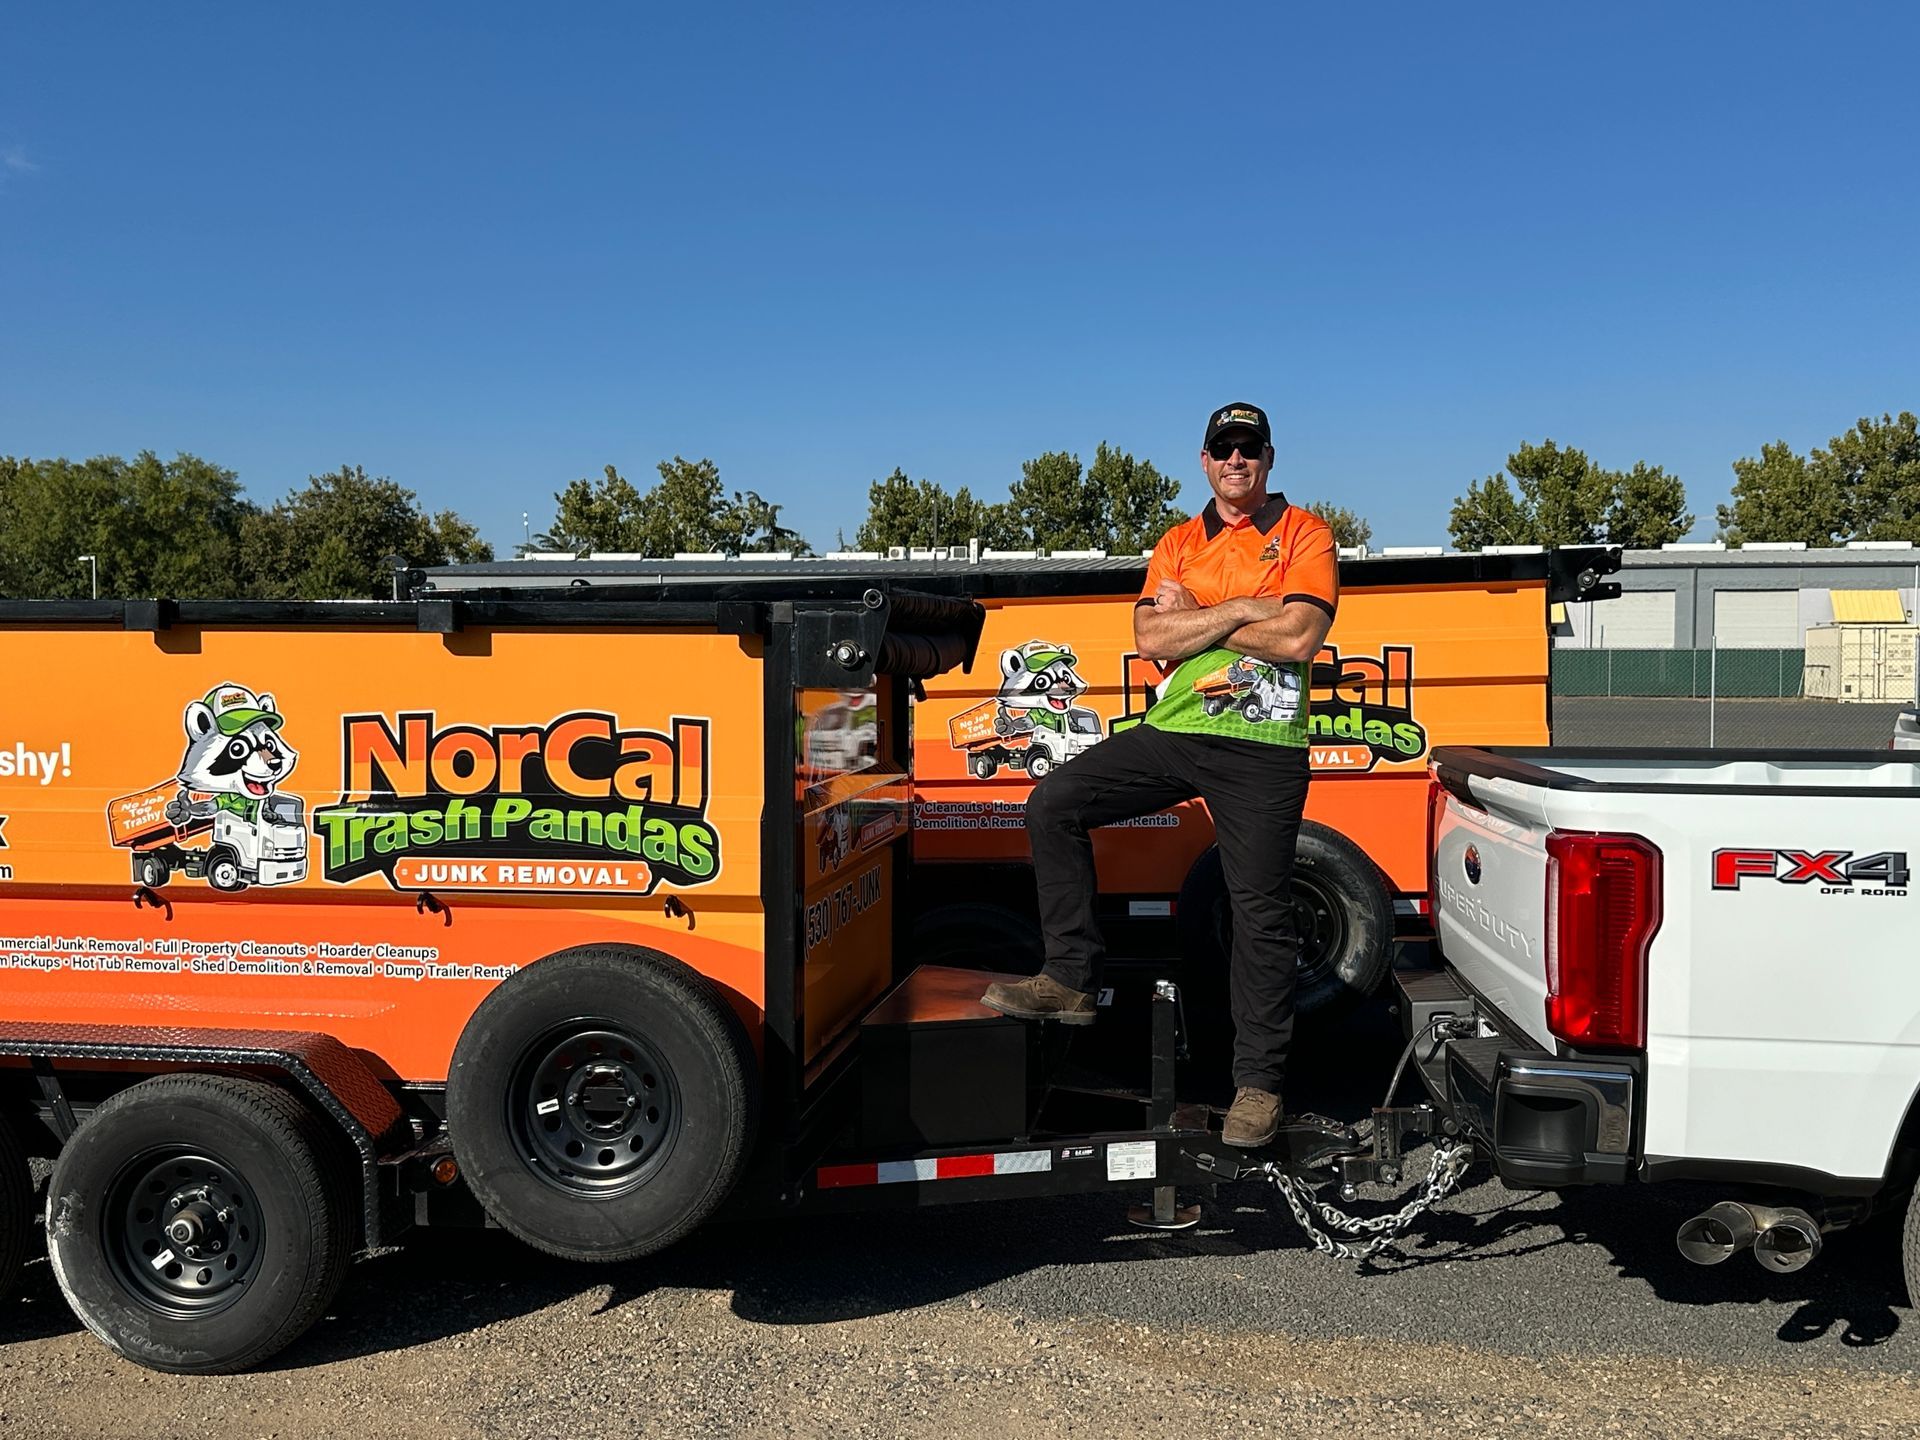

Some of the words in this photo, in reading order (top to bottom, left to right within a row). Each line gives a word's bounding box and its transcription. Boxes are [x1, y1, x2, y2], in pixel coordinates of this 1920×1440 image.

[346, 716, 705, 808] NorCal
[121, 802, 139, 811] No
[141, 795, 165, 806] Job
[129, 806, 153, 818] Too
[925, 802, 983, 812] Cleanouts
[123, 811, 160, 829] Trashy
[914, 818, 976, 828] Demolition
[980, 818, 989, 828] &
[992, 818, 1026, 828] Remo
[319, 799, 482, 870] Trash
[491, 798, 715, 877] Pandas
[415, 865, 488, 883] JUNK
[498, 866, 629, 885] REMOVAL
[1711, 848, 1910, 890] FX4
[1820, 887, 1855, 895] OFF
[1861, 888, 1907, 896] ROAD
[804, 893, 833, 960] (530)
[833, 864, 881, 931] 767-JUNK
[1479, 907, 1538, 958] DUTY
[54, 938, 84, 950] Junk
[88, 939, 142, 952] Removal
[155, 941, 177, 952] Full
[182, 941, 237, 956] Property
[241, 943, 306, 955] Cleanouts
[319, 944, 372, 957] Hoarder
[376, 945, 437, 960] Cleanups
[11, 955, 60, 969] Pickups
[73, 957, 95, 968] Hot
[98, 957, 121, 969] Tub
[125, 958, 179, 970] Removal
[192, 959, 225, 971] Shed
[229, 961, 299, 973] Demolition
[303, 962, 312, 973] &
[317, 963, 372, 975] Removal
[386, 964, 424, 979] Dump
[428, 965, 470, 977] Trailer
[474, 966, 517, 977] Rental
